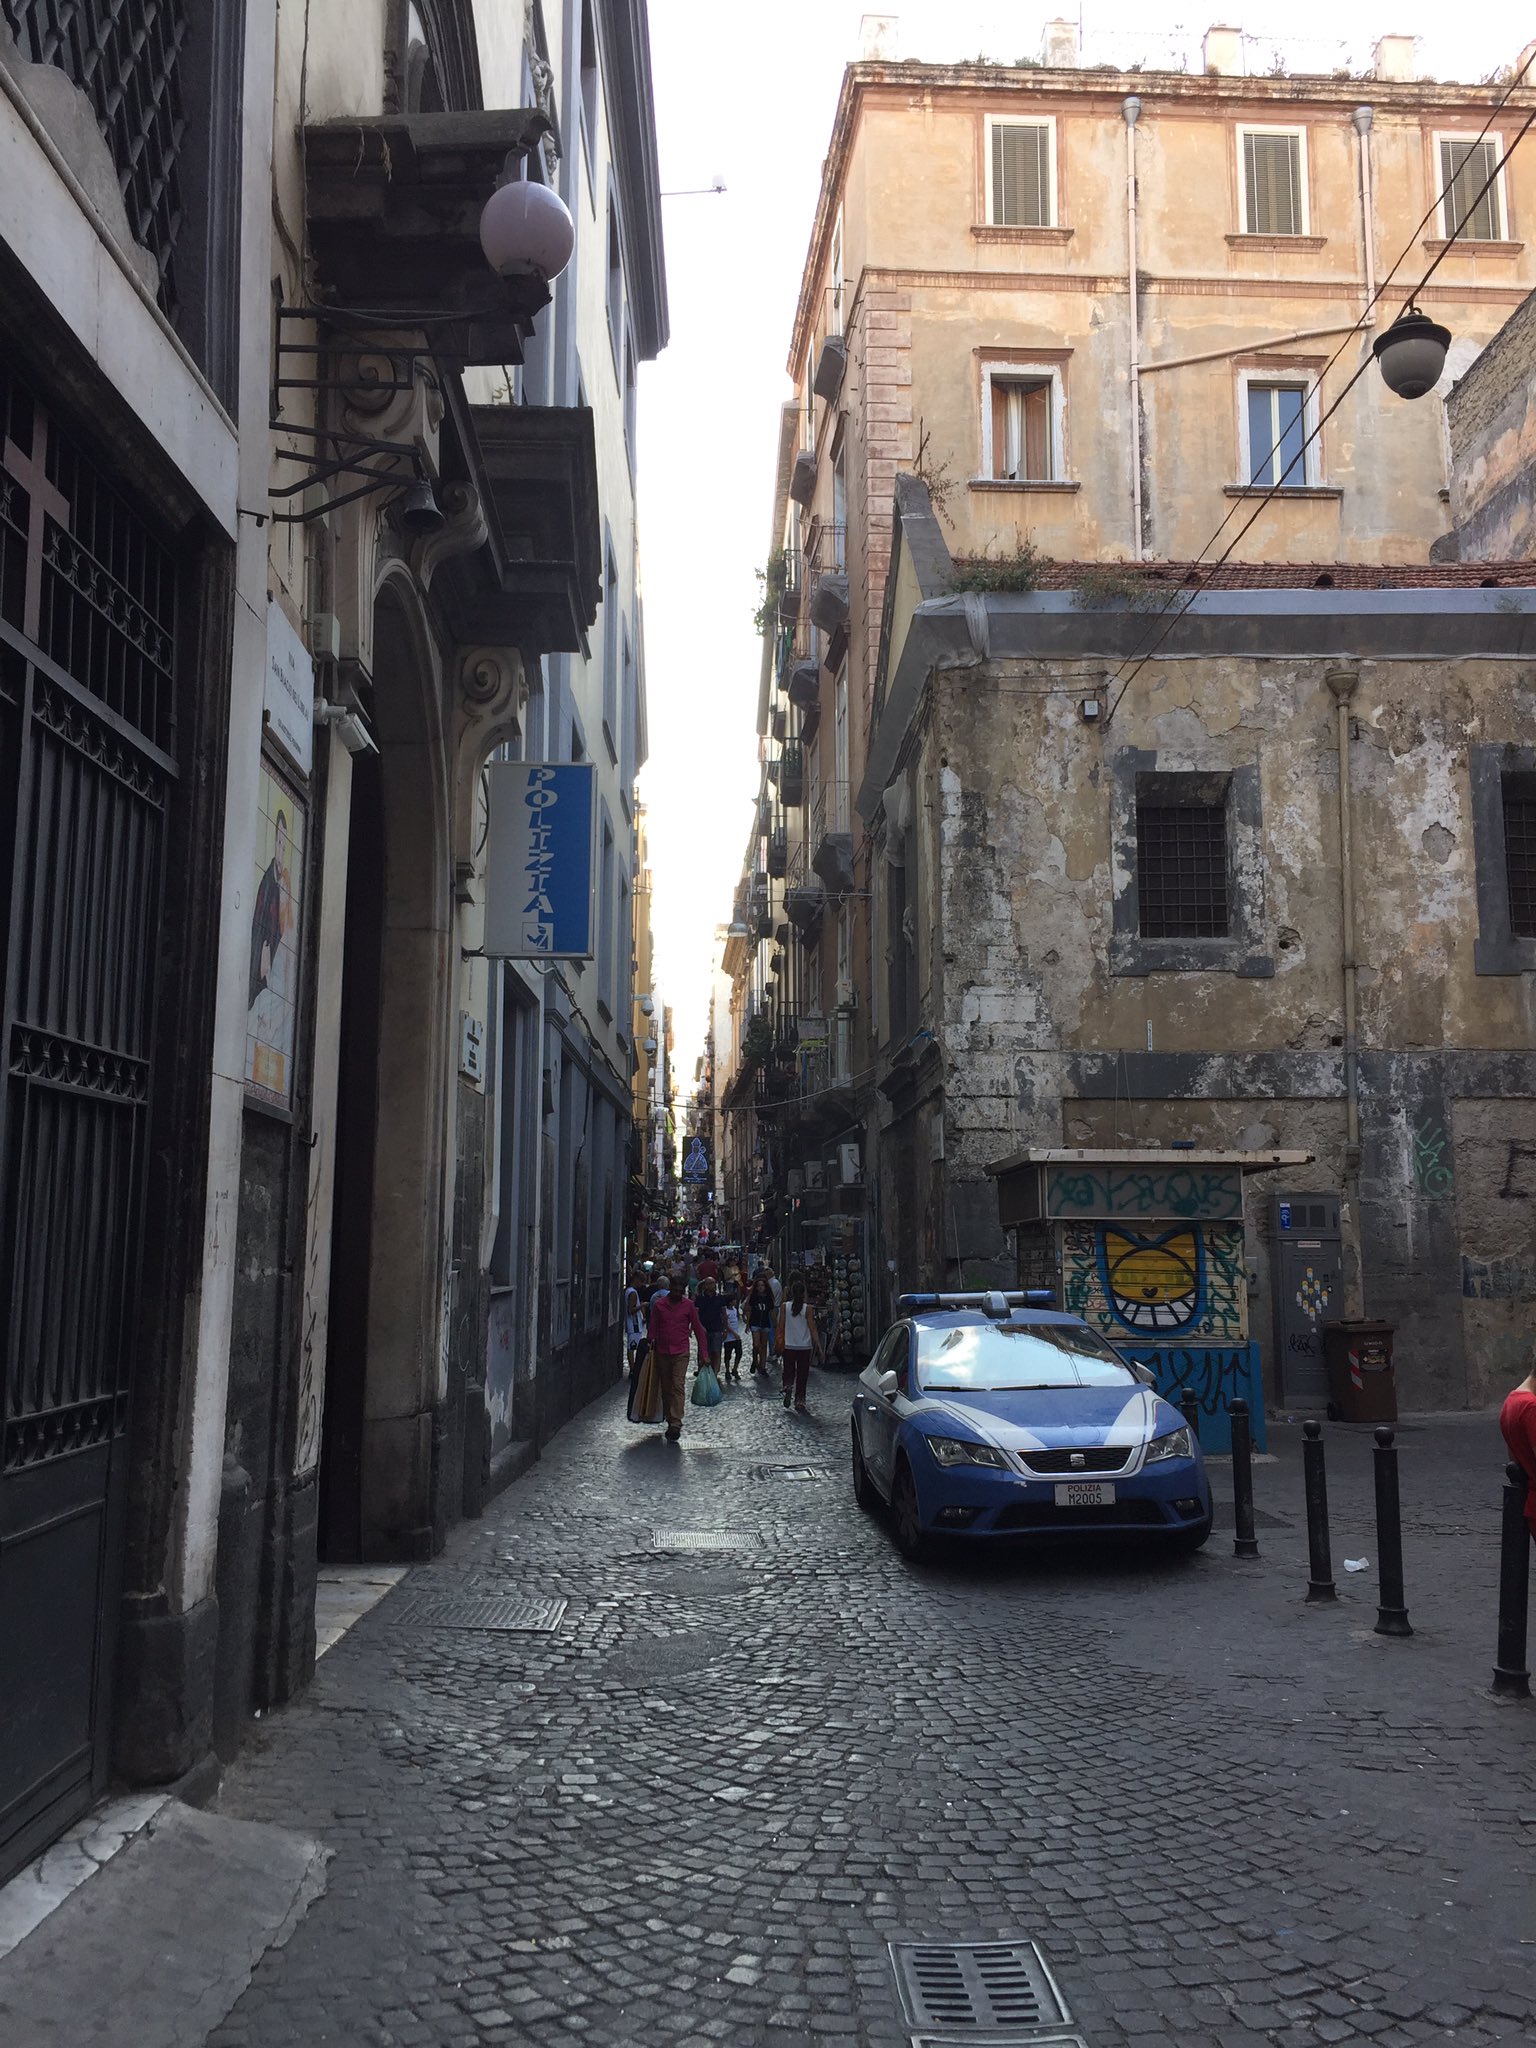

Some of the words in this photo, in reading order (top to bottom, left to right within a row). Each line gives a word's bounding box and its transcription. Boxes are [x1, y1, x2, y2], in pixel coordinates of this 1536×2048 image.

[522, 768, 559, 914] POLIZIA
[1067, 1484, 1102, 1492] POLIZIA
[1068, 1493, 1102, 1504] M2005
